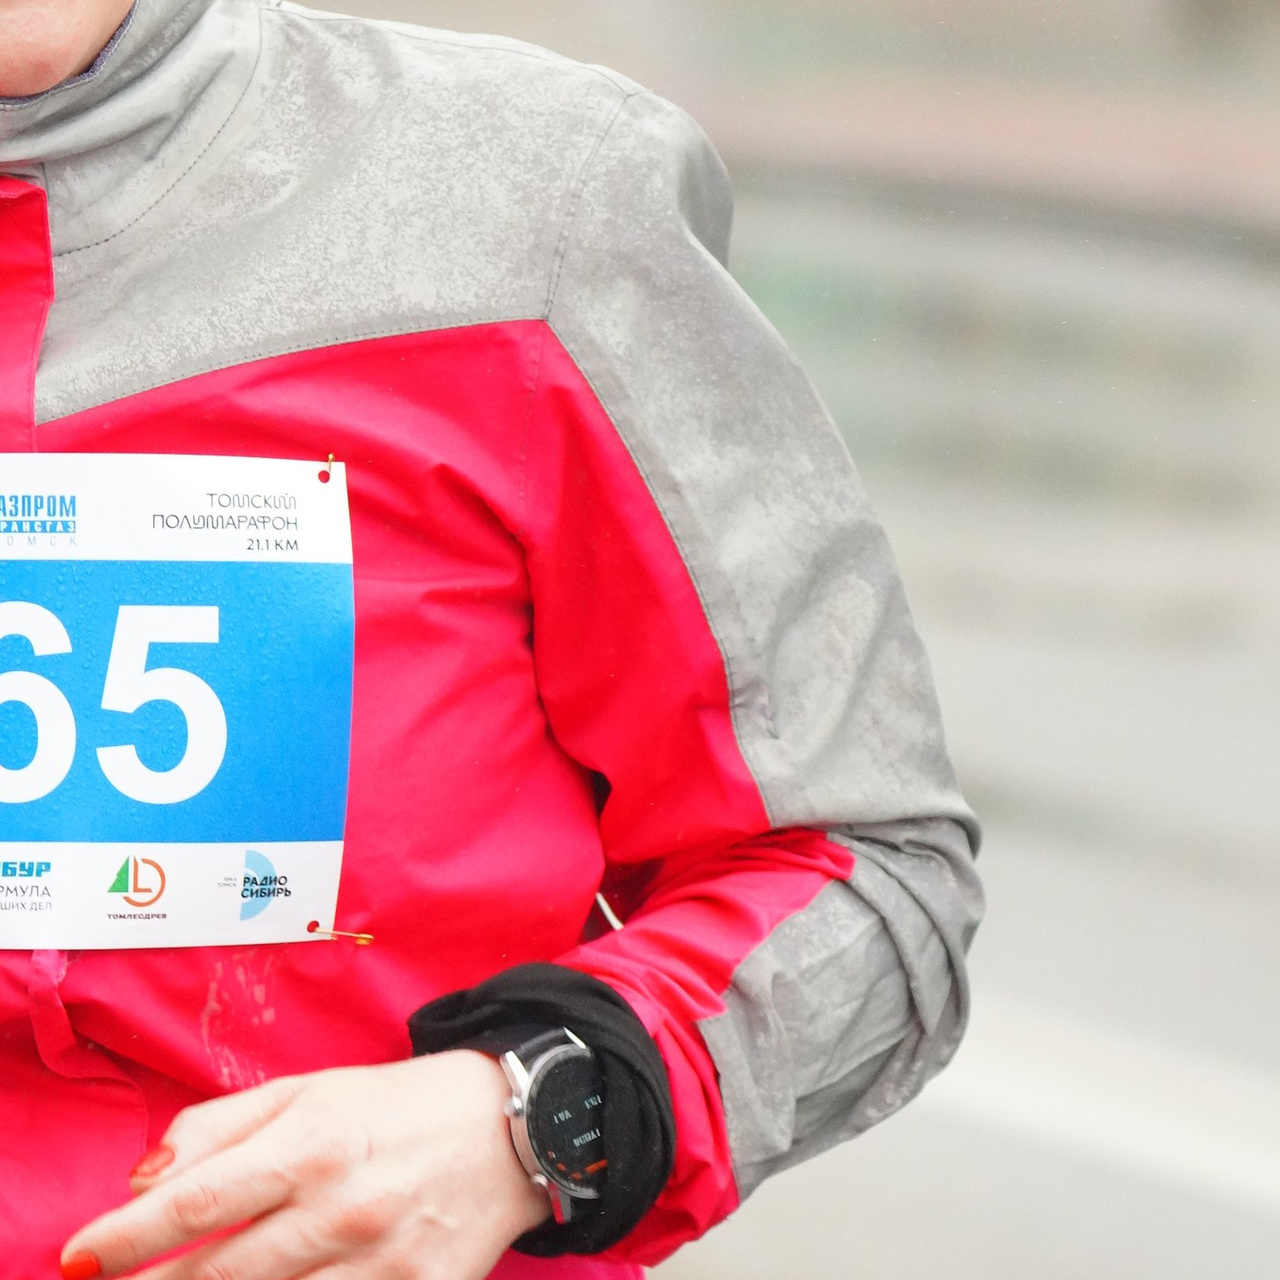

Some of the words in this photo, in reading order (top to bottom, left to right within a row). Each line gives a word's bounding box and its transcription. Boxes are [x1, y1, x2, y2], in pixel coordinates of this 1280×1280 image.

[206, 493, 297, 510] ТОМСКИЙ
[152, 514, 298, 531] ПОЛУМАРАФОН
[246, 538, 270, 551] 21.1
[274, 539, 299, 551] КМ
[243, 876, 288, 887] РАДИО
[241, 887, 292, 898] СИБИРЬ
[29, 901, 52, 911] ДЕЛ
